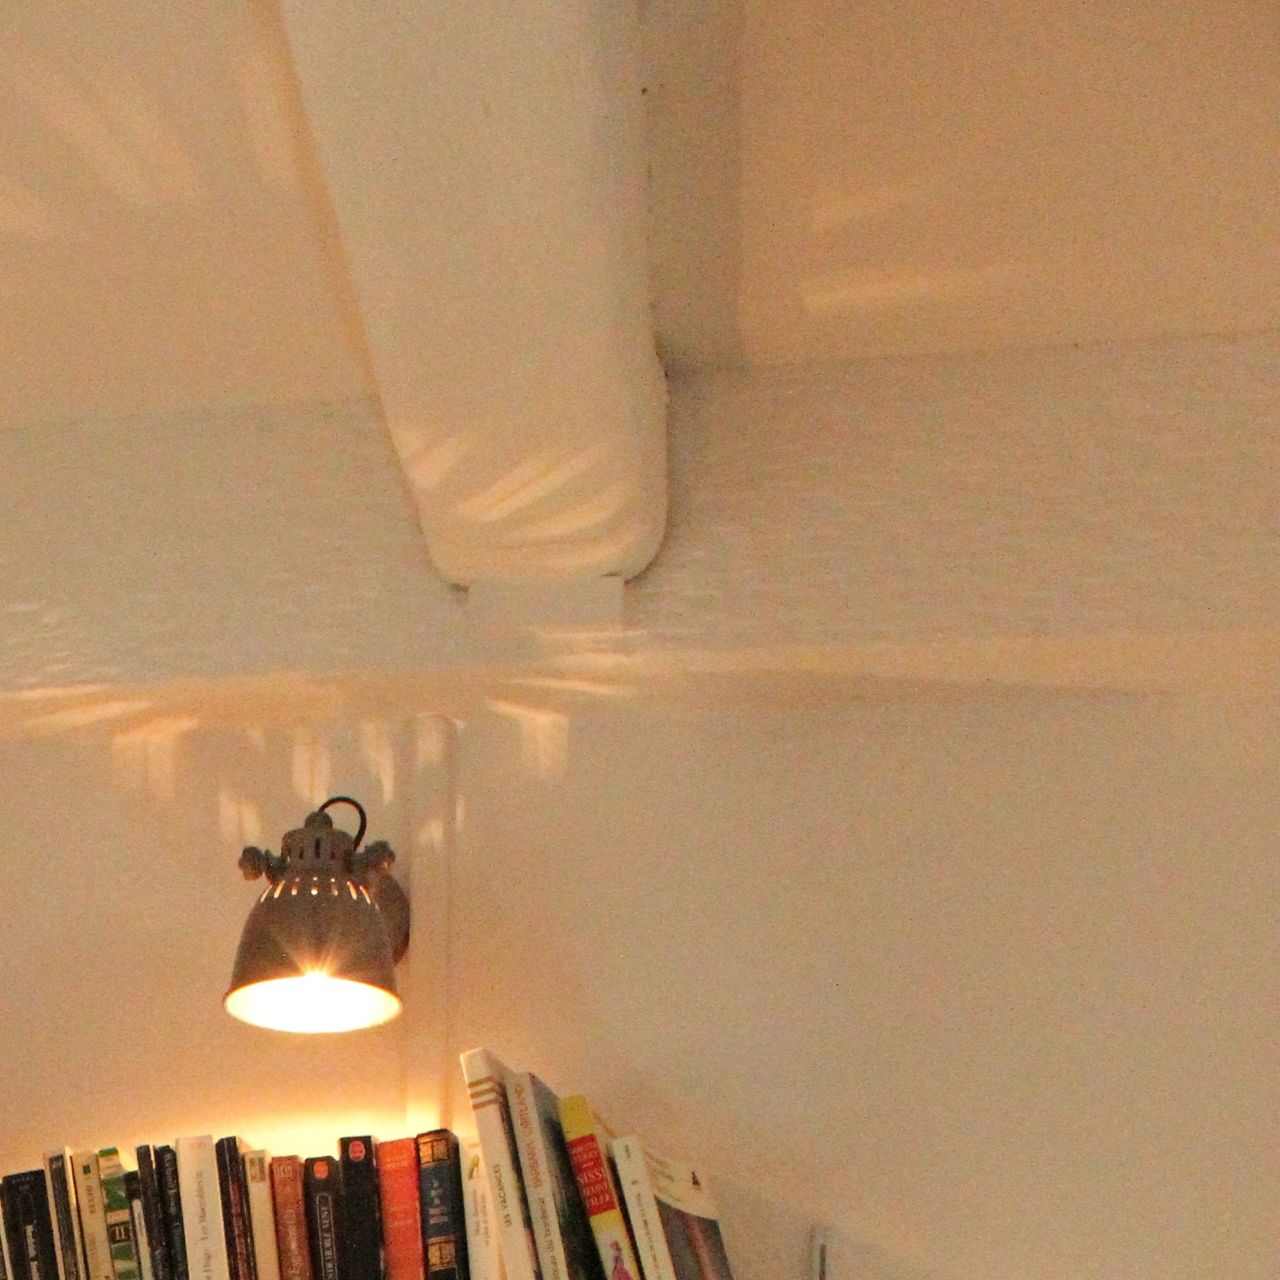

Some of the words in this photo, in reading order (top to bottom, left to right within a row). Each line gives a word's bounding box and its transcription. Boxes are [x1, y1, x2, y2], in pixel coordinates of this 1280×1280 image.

[515, 1084, 533, 1137] CARTLAND
[493, 1164, 508, 1209] VACANCES
[525, 1142, 542, 1187] BARBARA
